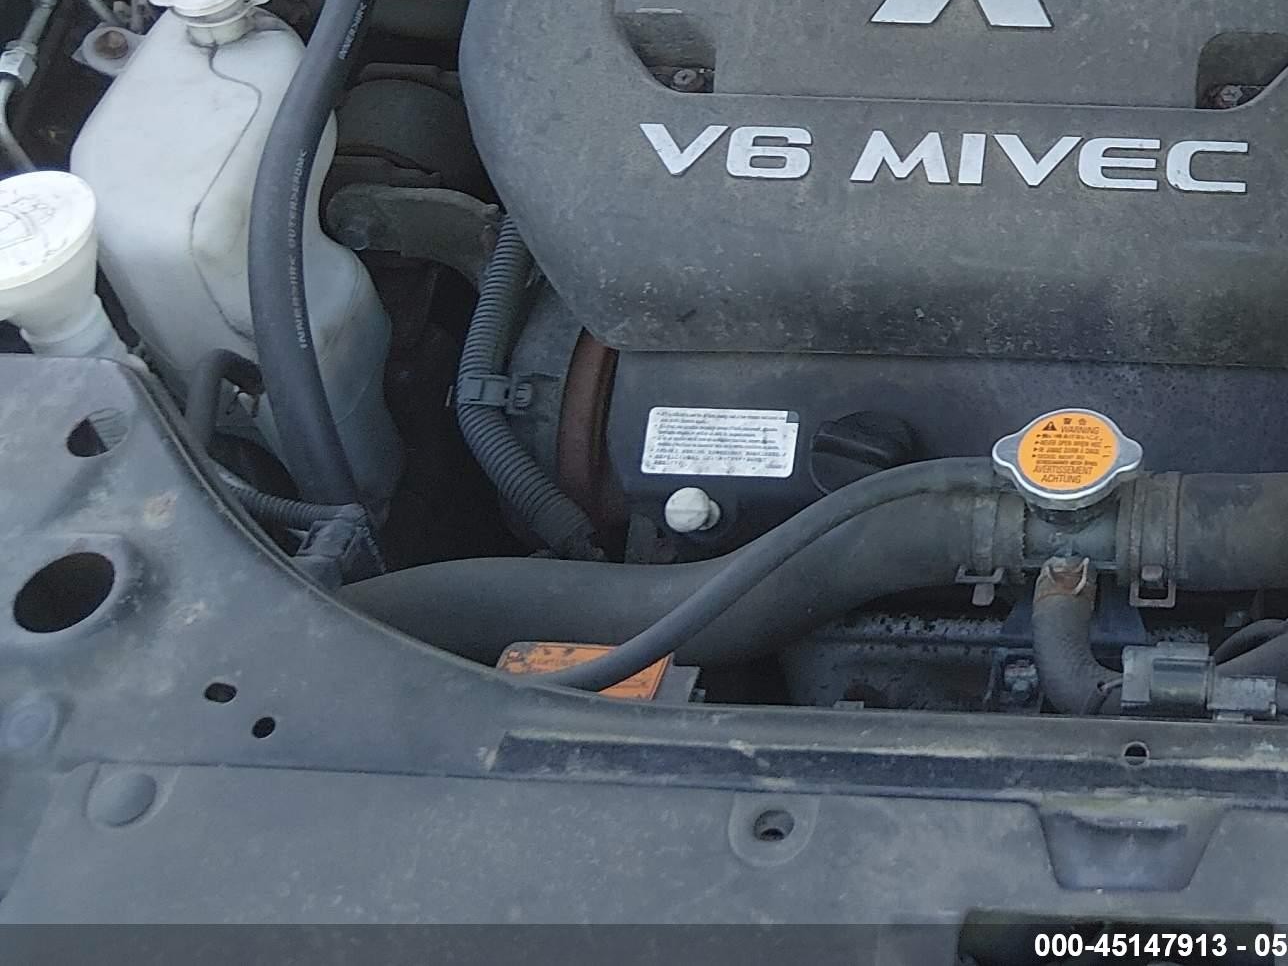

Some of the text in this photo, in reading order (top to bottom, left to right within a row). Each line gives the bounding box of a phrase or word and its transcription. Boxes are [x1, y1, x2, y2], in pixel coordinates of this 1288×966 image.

[640, 123, 1249, 193] V6 MIVEC
[1061, 425, 1100, 434] WARNING
